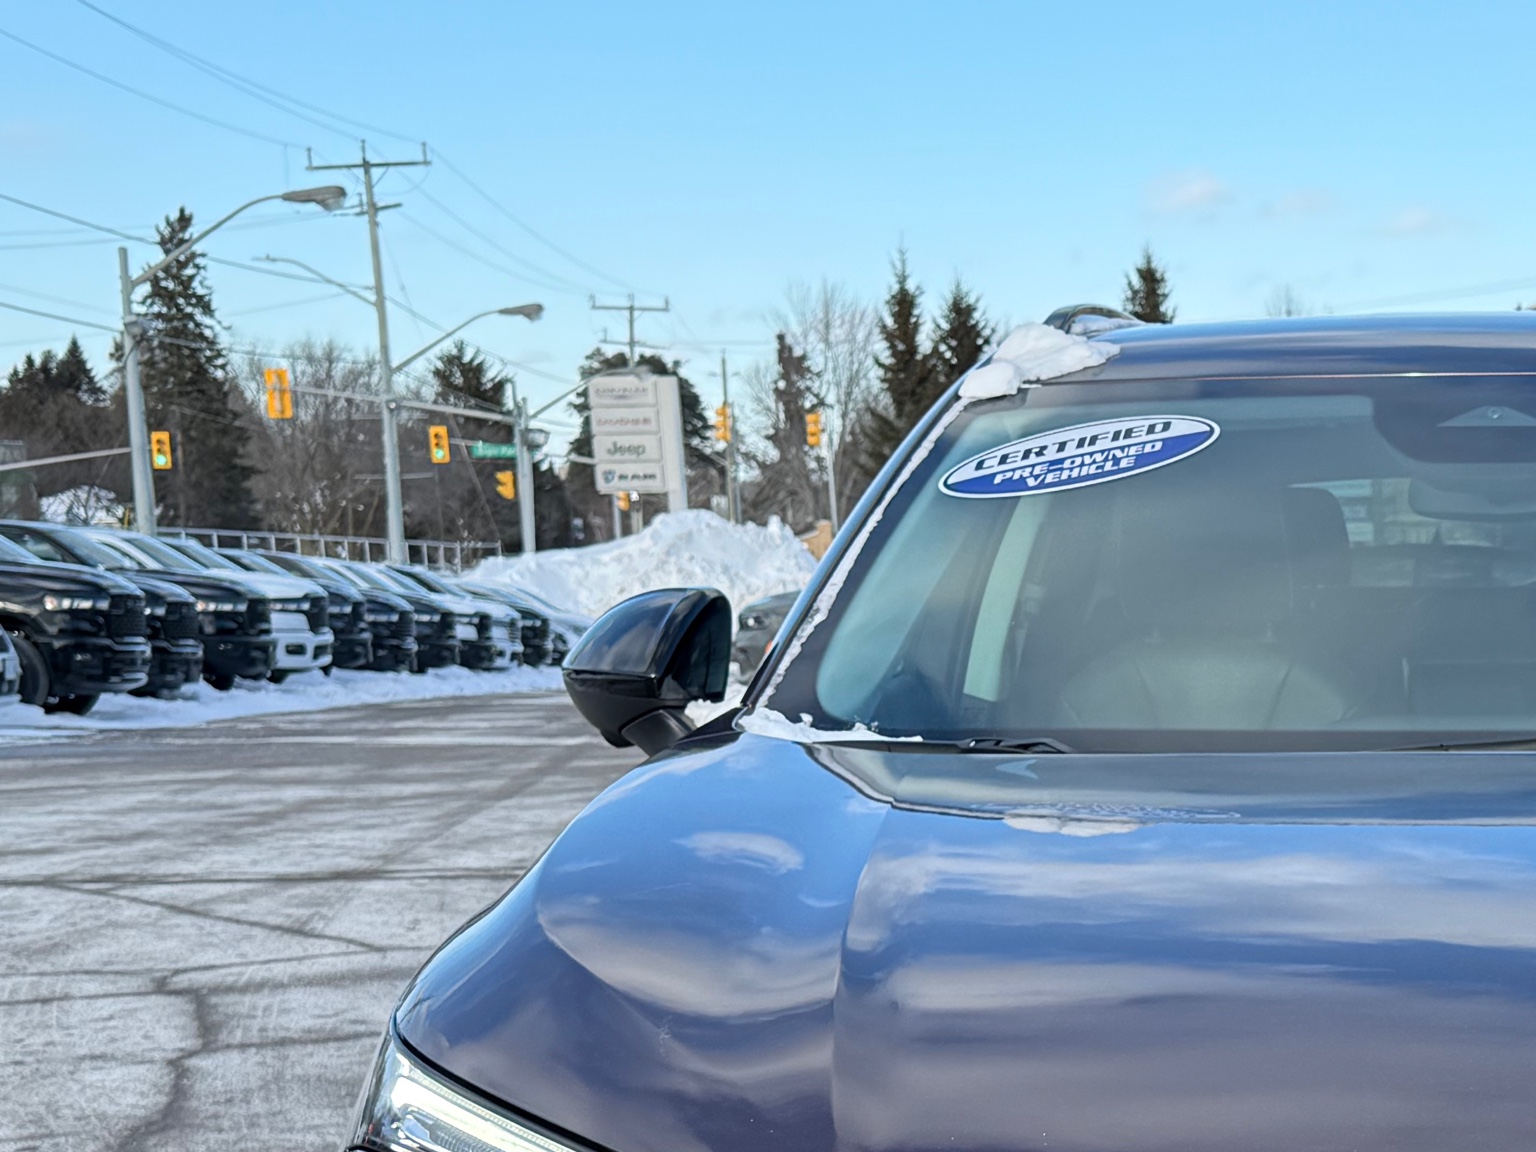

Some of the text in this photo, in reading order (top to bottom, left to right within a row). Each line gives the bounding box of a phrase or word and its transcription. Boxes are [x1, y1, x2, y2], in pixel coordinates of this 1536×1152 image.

[607, 441, 646, 457] Jeep
[974, 421, 1172, 472] CERTIFIED
[993, 441, 1163, 485] PRE-OWNED
[1024, 456, 1136, 488] VEHICLE
